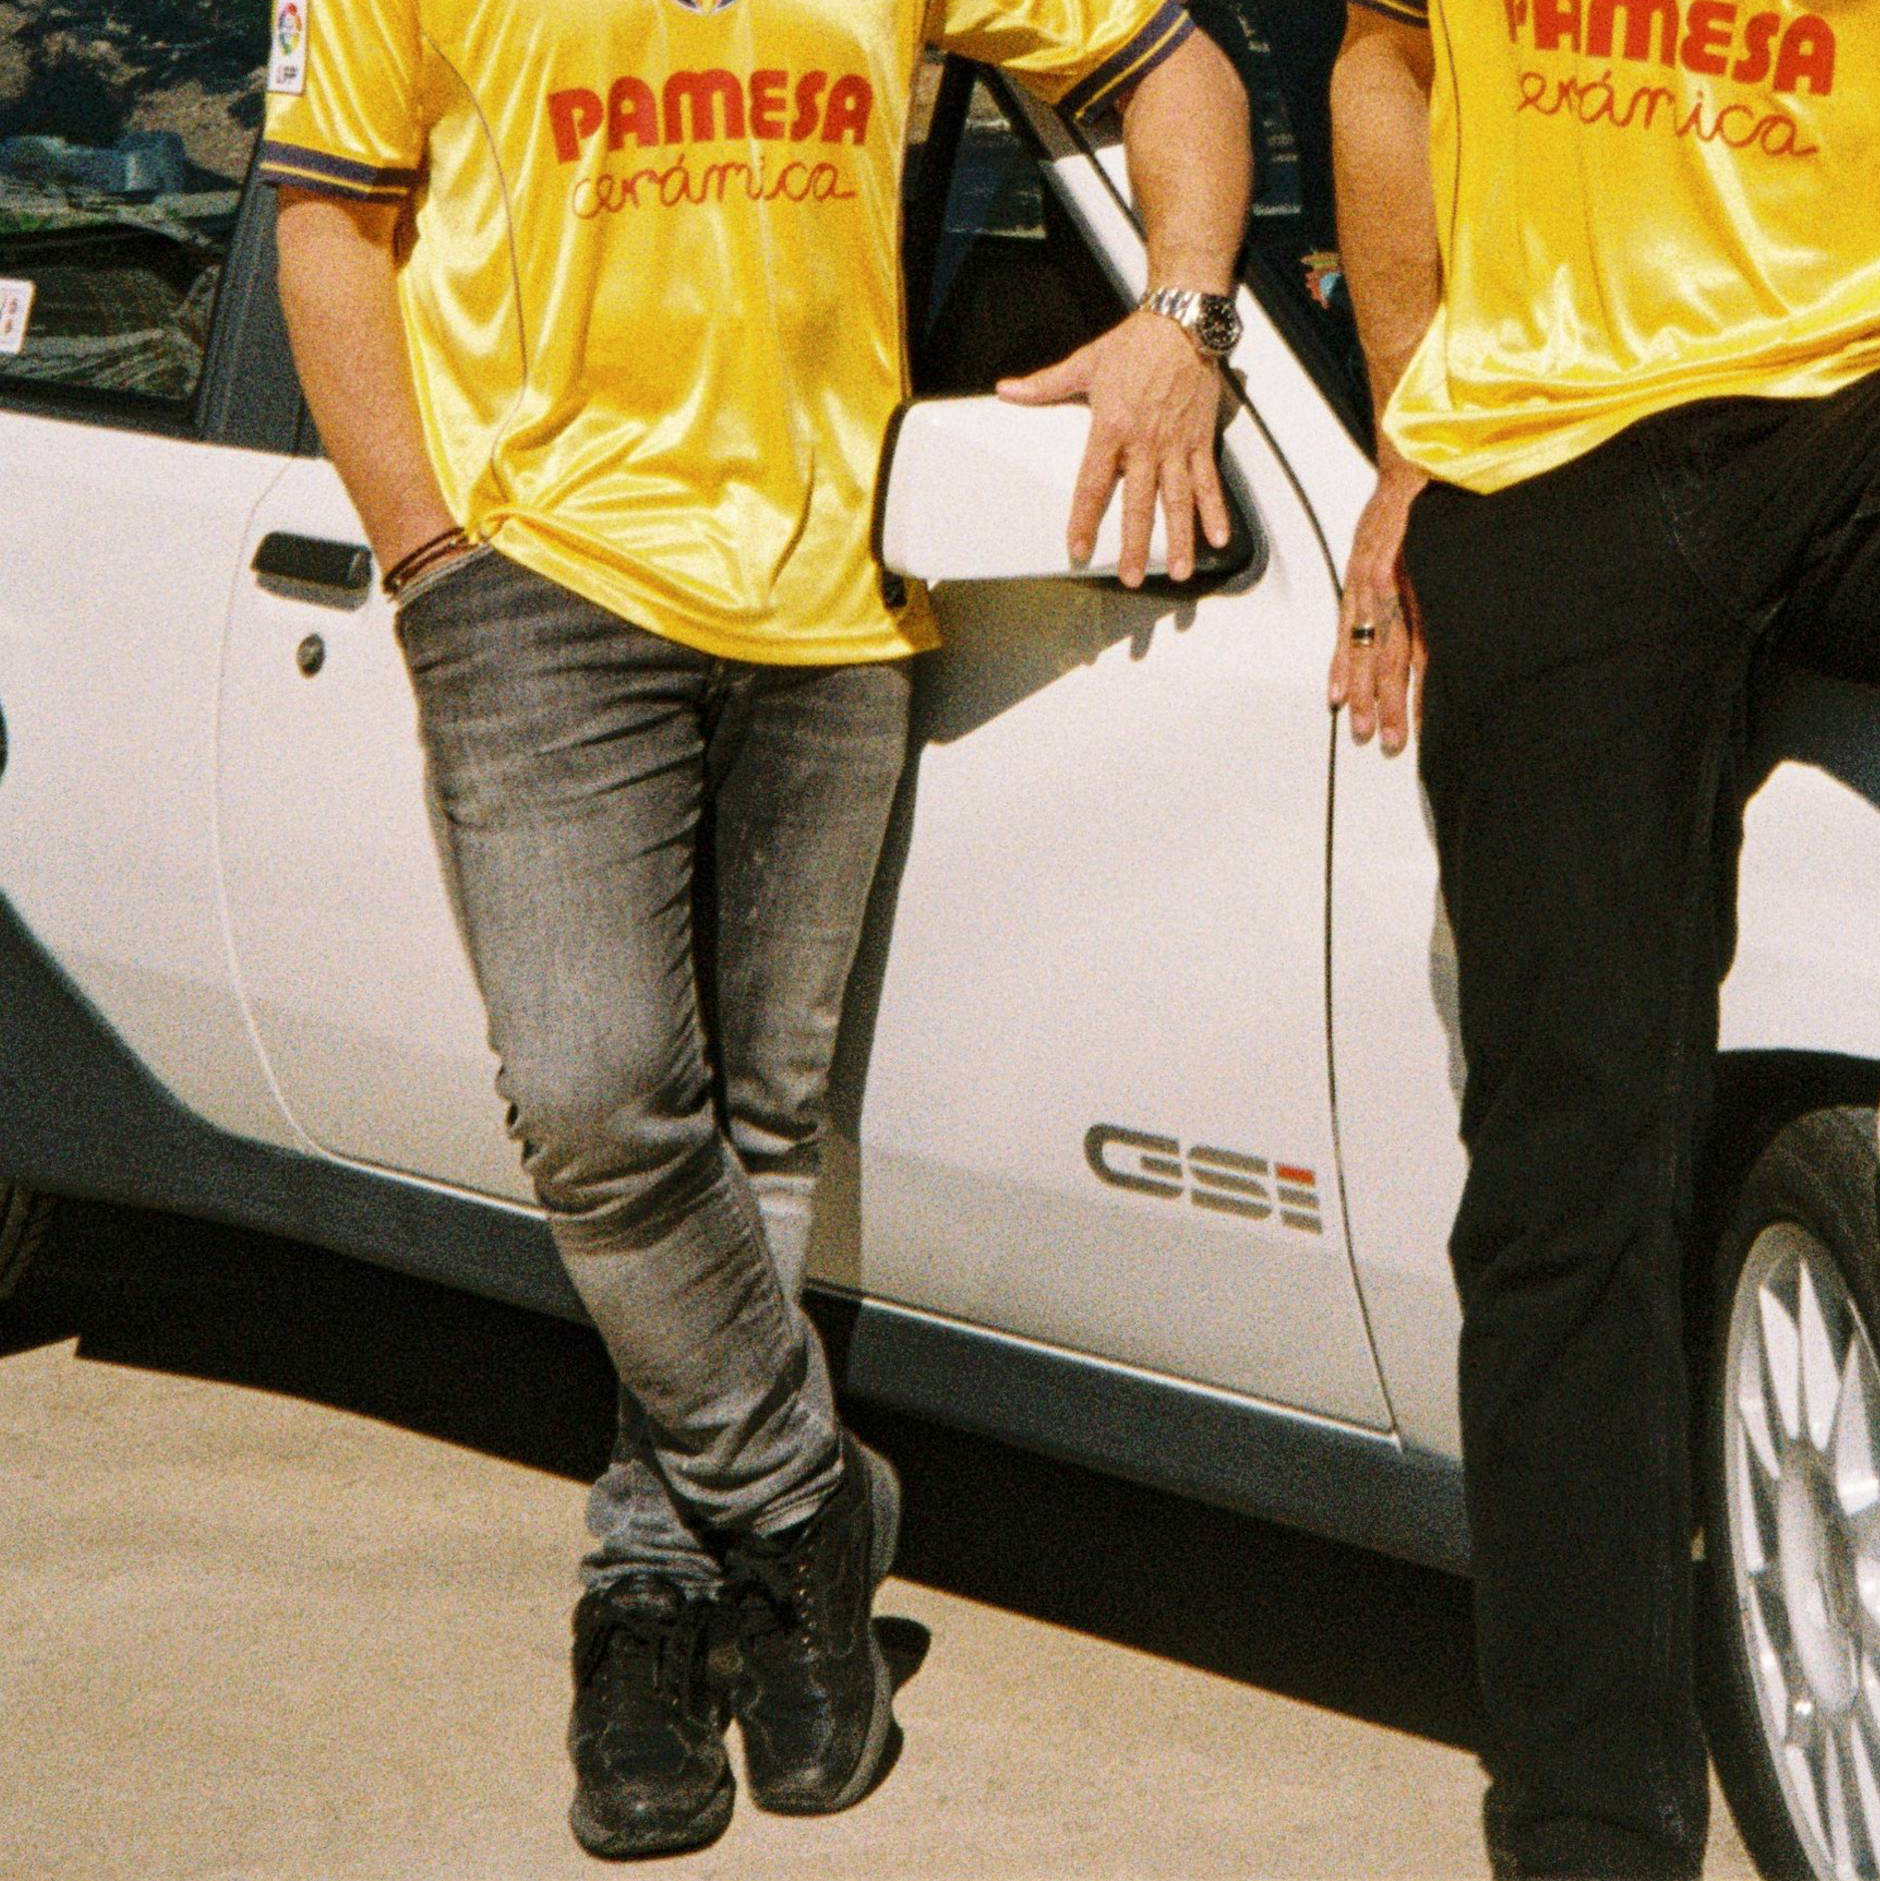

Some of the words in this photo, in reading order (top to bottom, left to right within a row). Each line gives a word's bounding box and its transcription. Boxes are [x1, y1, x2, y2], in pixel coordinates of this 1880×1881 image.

[546, 67, 874, 165] PAMESA
[1516, 69, 1820, 157] erámica
[572, 153, 857, 219] cerámica
